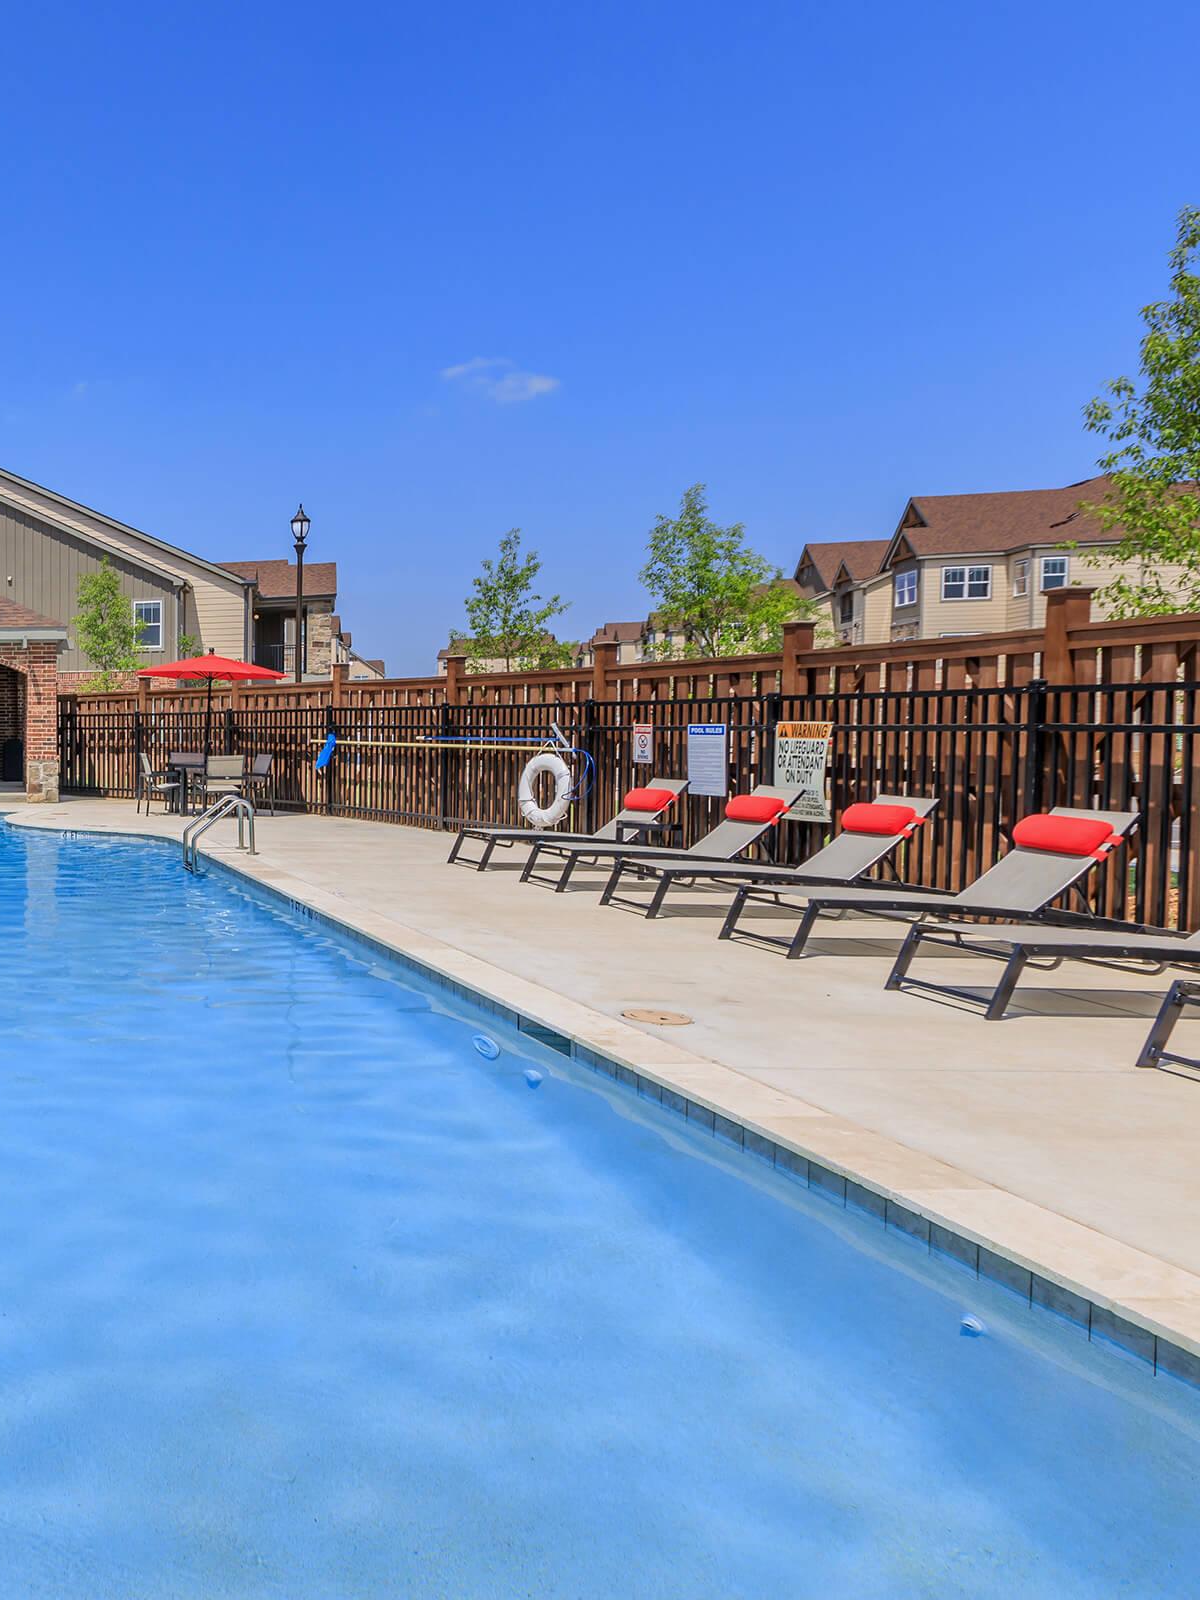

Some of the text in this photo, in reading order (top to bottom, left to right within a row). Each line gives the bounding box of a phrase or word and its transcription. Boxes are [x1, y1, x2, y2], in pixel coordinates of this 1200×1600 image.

[792, 723, 828, 738] WARNING
[778, 740, 825, 755] NO LIFEGUARD
[777, 754, 823, 770] OR ATTENDANT
[785, 769, 813, 785] ON DUTY
